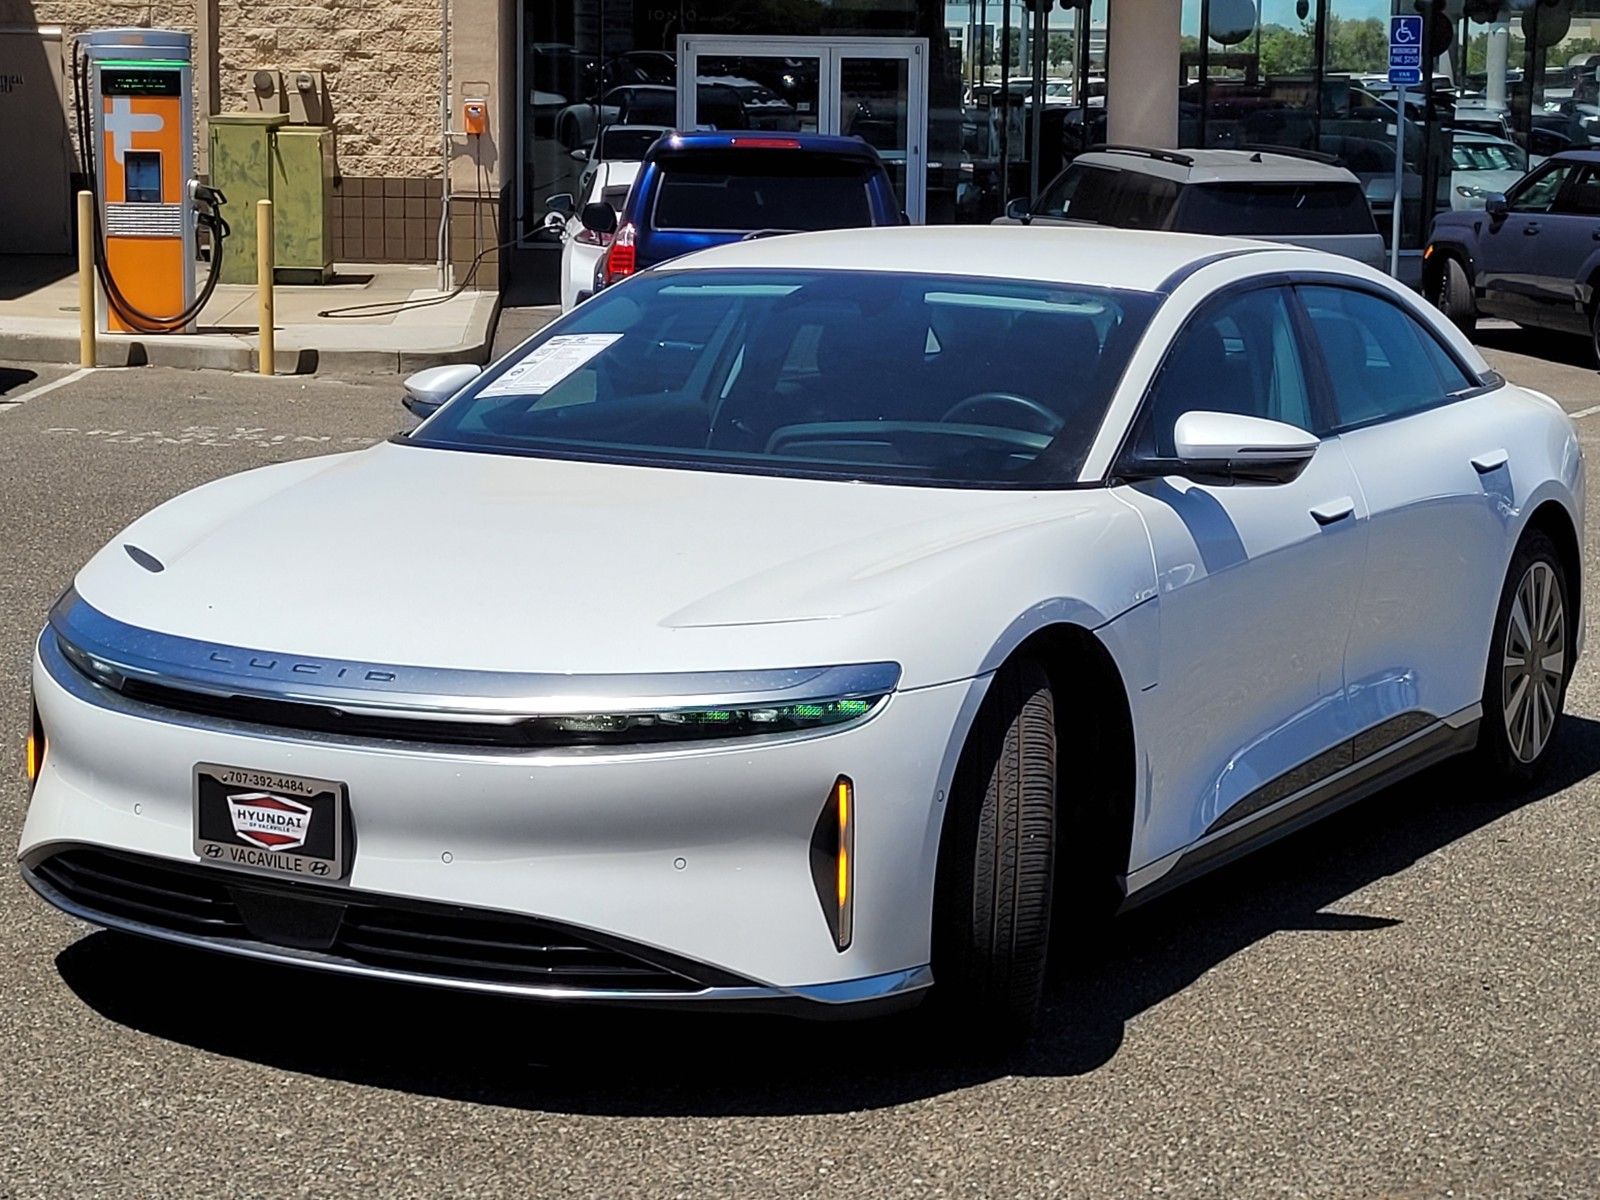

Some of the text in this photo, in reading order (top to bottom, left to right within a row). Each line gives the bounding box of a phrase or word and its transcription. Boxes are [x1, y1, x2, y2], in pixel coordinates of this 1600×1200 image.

[648, 9, 696, 21] IONQ
[210, 652, 396, 682] LUCID
[229, 771, 304, 792] 707-392-4484
[237, 809, 302, 828] HYUNDAI
[258, 823, 290, 833] VACAVILLE
[230, 848, 303, 872] VACAVILLE
